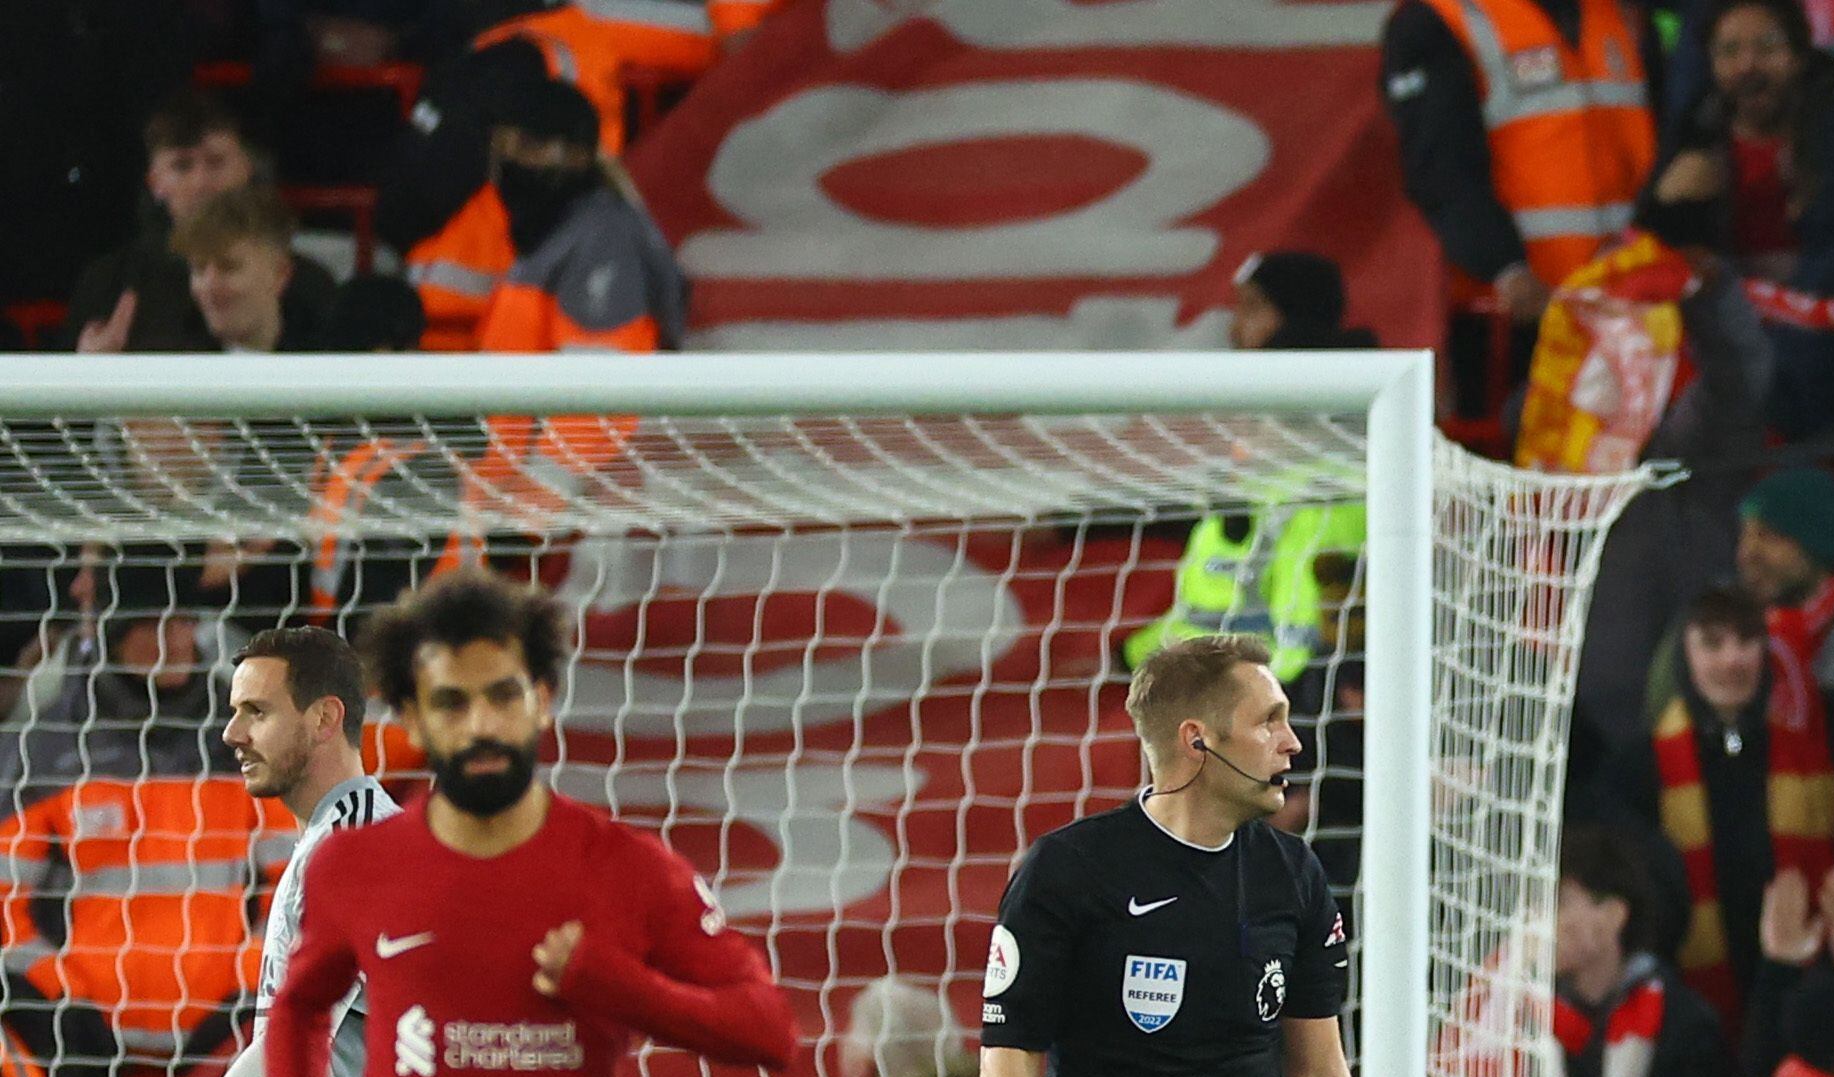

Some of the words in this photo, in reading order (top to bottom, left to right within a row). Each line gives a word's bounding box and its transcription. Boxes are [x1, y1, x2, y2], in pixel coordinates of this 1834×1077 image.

[1130, 960, 1179, 981] FIFA
[1127, 989, 1178, 1003] REFEREE
[1138, 1015, 1163, 1025] 2022
[444, 1020, 576, 1047] standard
[444, 1042, 583, 1070] chartered
